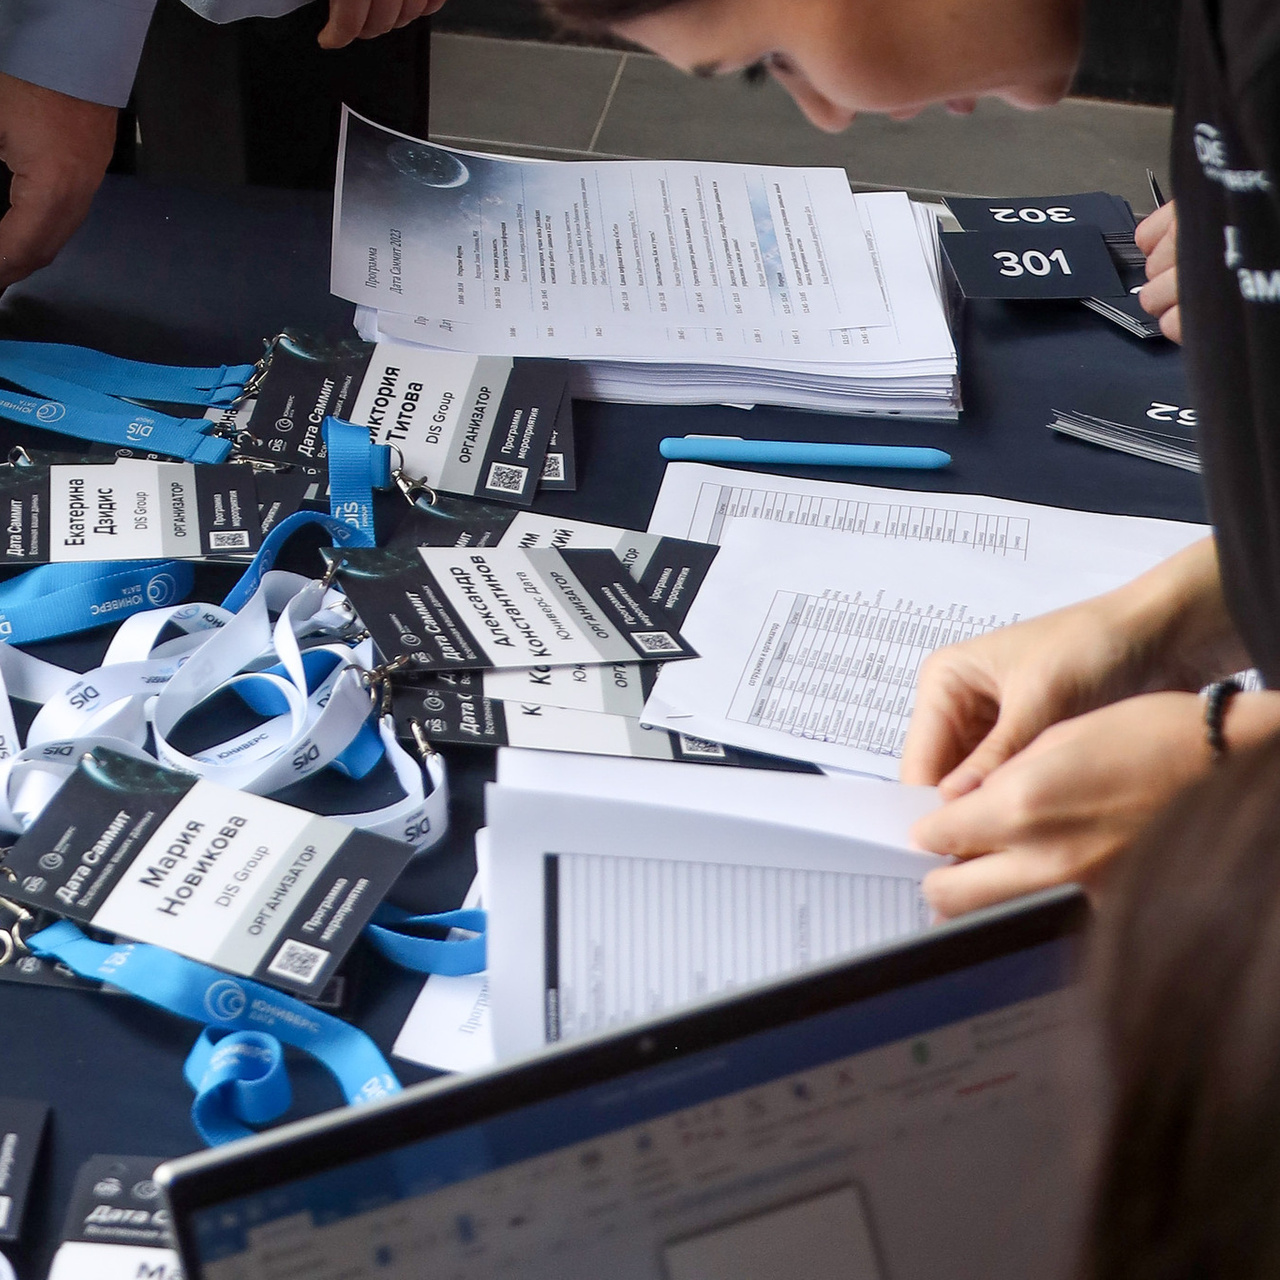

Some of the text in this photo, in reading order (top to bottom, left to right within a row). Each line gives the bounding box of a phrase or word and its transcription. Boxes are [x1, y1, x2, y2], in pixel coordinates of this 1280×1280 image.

[989, 206, 1075, 223] 302
[366, 247, 380, 288] Программа
[390, 229, 403, 294] Дата Саммит 2023
[993, 248, 1072, 277] 301
[127, 422, 154, 438] DIS
[298, 378, 335, 457] Дата Саммит
[370, 366, 400, 442] иктория
[387, 381, 424, 440] Титова
[425, 391, 454, 445] DIS Group
[459, 385, 492, 463] ОРГАНИЗАТОР
[501, 408, 523, 454] Программа
[271, 439, 283, 451] DIS
[518, 406, 540, 460] мероприятия
[6, 500, 25, 556] Дата Саммит
[65, 478, 85, 546] Екатерина
[94, 487, 118, 536] Дзидис
[135, 491, 149, 530] DIS Group
[174, 482, 186, 538] ОРГАНИЗАТОР
[214, 494, 225, 525] Программа
[90, 594, 144, 616] ЮНИВЕРС
[449, 565, 518, 648] Александр
[470, 555, 552, 657] Константинов
[516, 570, 574, 641] Юниверс Дата
[550, 571, 609, 640] ОРГАНИЗАТОР
[665, 567, 691, 608] мероприятия
[405, 591, 465, 661] Дата Саммит
[70, 686, 100, 711] DIS
[431, 718, 443, 732] DIS
[460, 702, 480, 735] Дата
[217, 733, 268, 760] ЮНИВЕРС
[293, 744, 320, 771] DIS
[139, 819, 205, 890] Мария
[405, 817, 432, 842] DIS
[55, 811, 131, 904] Дата Саммит
[157, 816, 248, 917] Новикова
[215, 844, 271, 907] DIS Group
[248, 845, 317, 936] ОРГАНИЗАТОР
[304, 878, 348, 933] Программа
[320, 878, 370, 940] мероприятия
[251, 998, 320, 1033] ЮНИВЕРС
